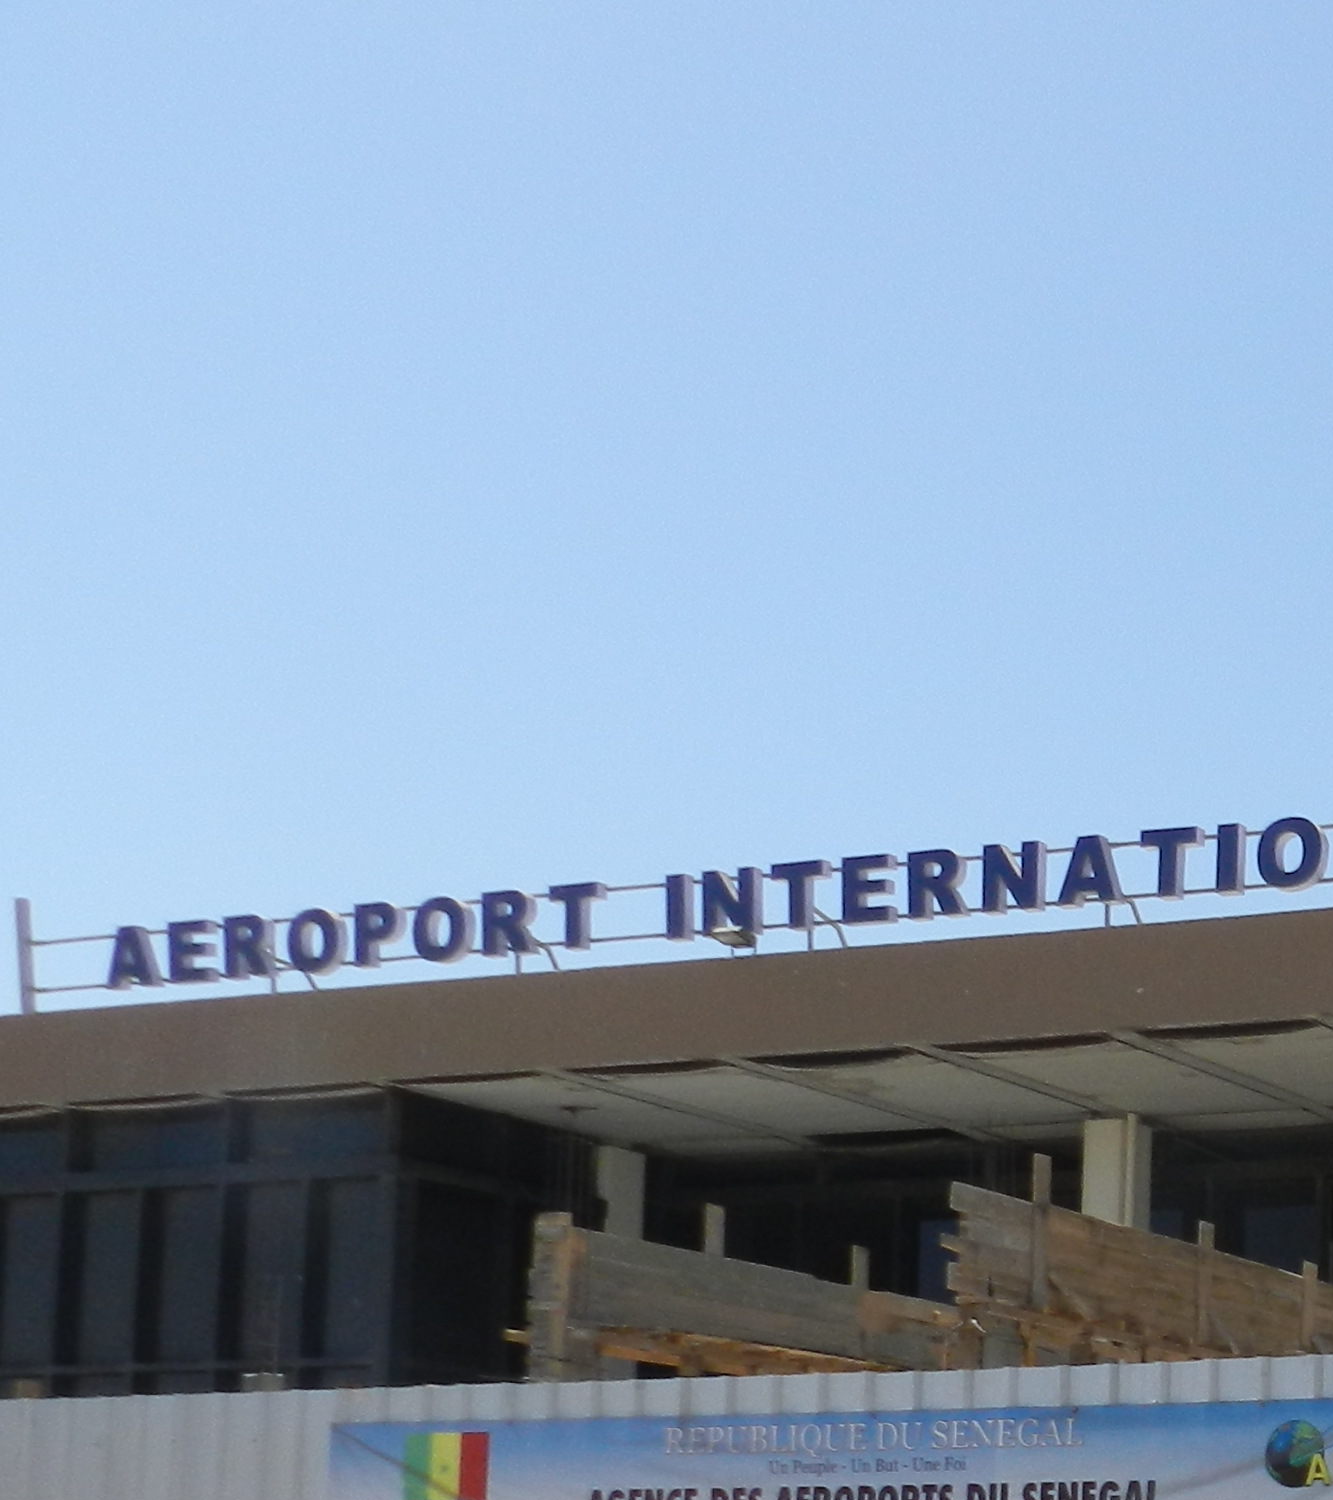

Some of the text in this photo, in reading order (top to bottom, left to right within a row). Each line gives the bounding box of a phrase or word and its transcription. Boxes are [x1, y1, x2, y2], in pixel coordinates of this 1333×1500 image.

[107, 882, 607, 991] AEROPORT
[664, 1418, 1084, 1457] REPUBLIQUE DU SENEGAL
[769, 1461, 788, 1474] Un
[793, 1460, 837, 1477] Peuple
[851, 1459, 871, 1473] Un
[876, 1458, 898, 1472] But
[912, 1457, 940, 1471] Une
[944, 1456, 967, 1470] Foi
